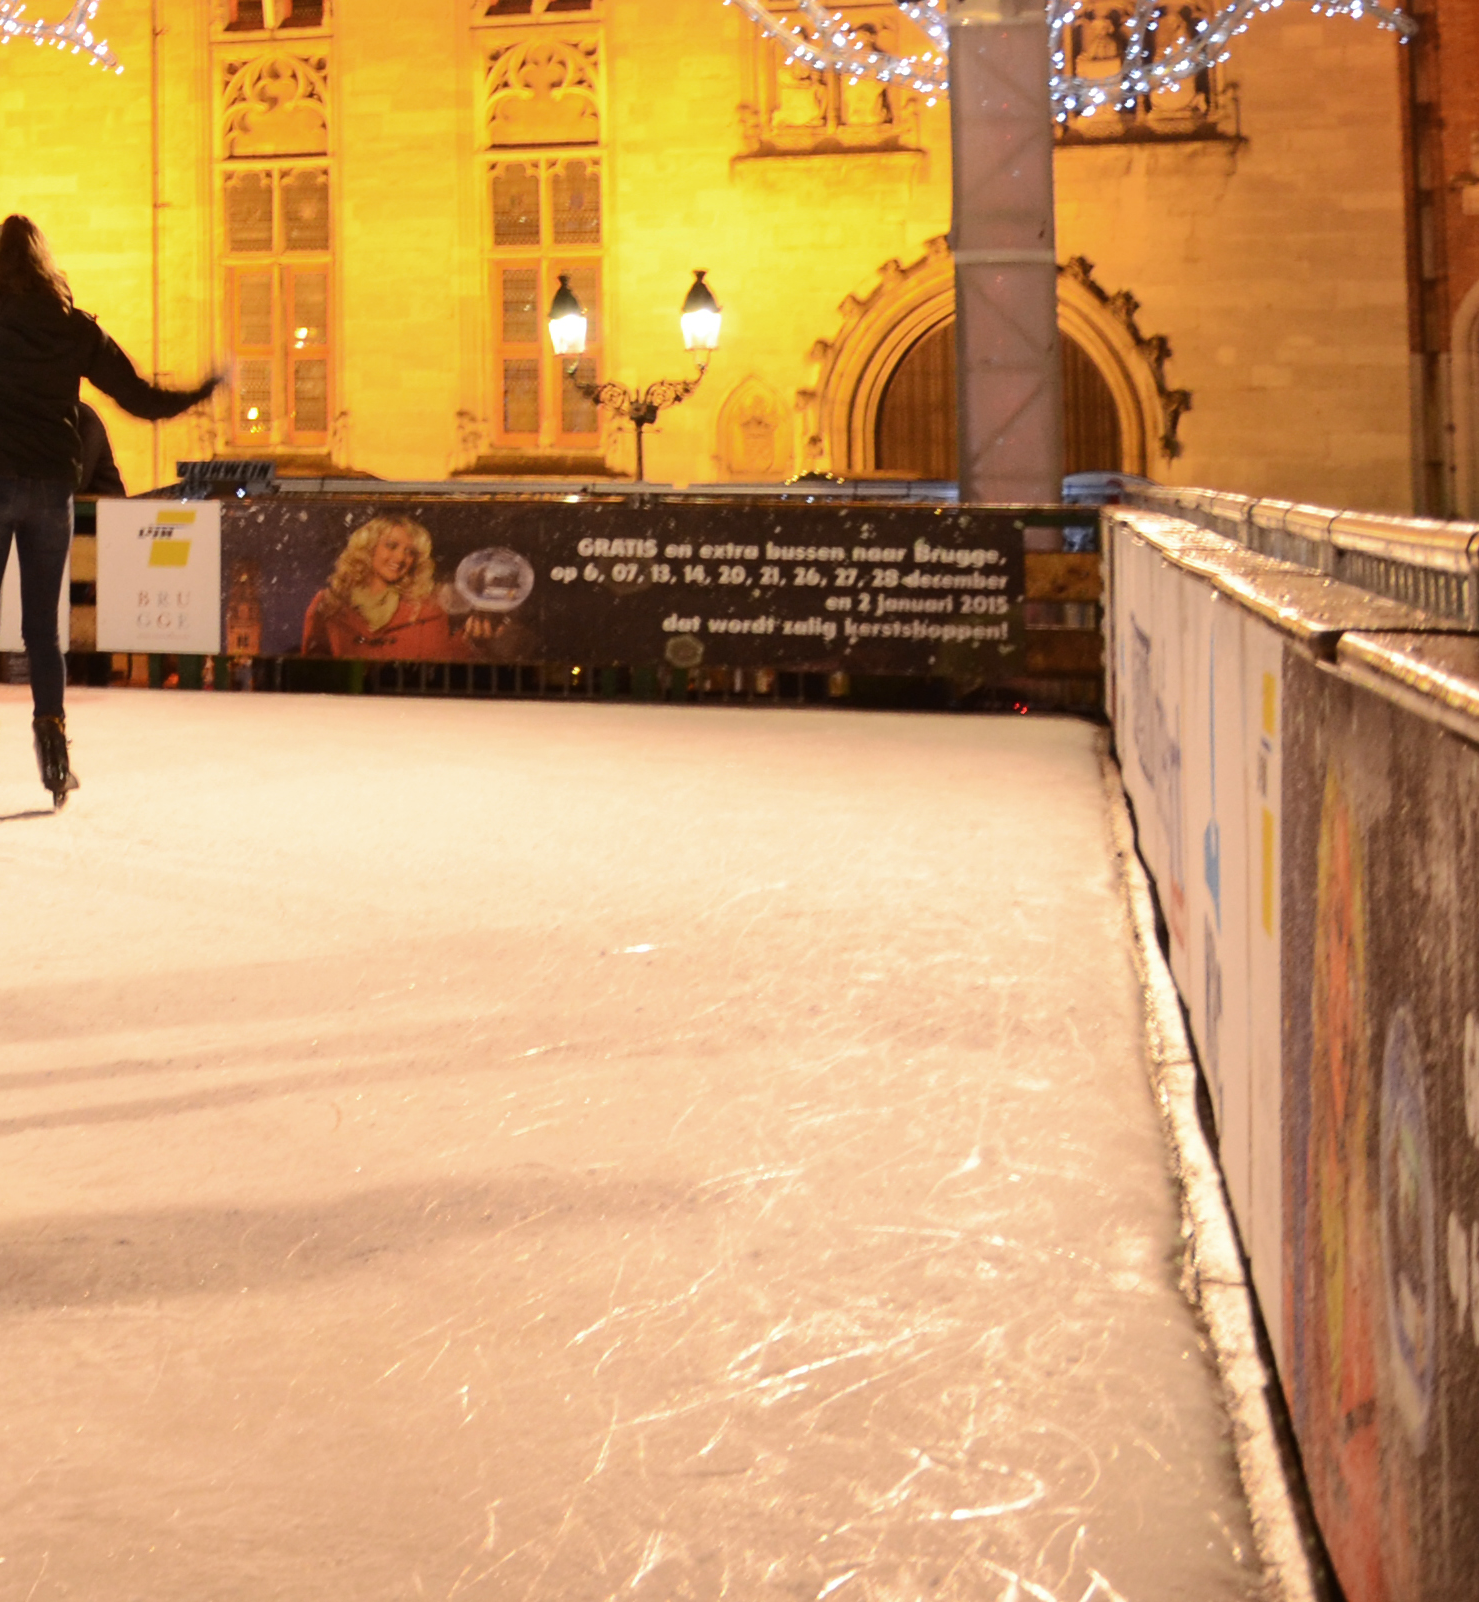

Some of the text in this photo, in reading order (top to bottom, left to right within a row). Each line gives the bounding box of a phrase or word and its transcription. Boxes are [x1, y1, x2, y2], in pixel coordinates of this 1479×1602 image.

[577, 537, 1007, 568] GRATIS en extra bussen naar Brugge,
[550, 563, 1008, 590] op 6, 07, 13, 14, 20, 21, 26, 27, 28 december
[137, 591, 191, 608] BRU
[825, 592, 1009, 617] en 2 januari 2015
[661, 612, 702, 632] dat
[707, 615, 775, 634] wordt
[782, 616, 837, 640] zalig
